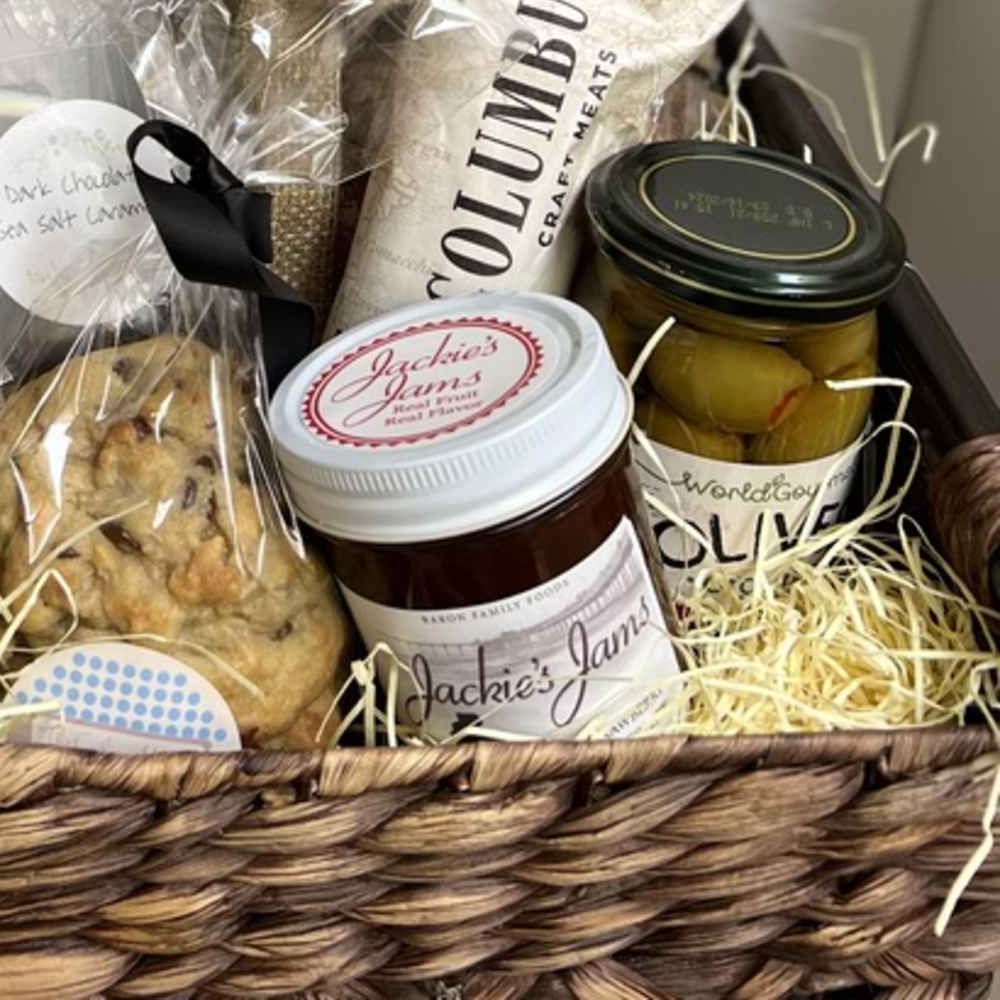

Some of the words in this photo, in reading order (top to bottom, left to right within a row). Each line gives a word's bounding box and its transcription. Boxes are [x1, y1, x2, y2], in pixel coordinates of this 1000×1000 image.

[538, 156, 575, 248] CRAFT
[573, 48, 617, 141] MEATS
[3, 177, 52, 205] Dark
[36, 208, 78, 235] Salt
[331, 332, 498, 403] Jackie's
[342, 369, 482, 428] Jams
[392, 398, 430, 415] Real
[434, 389, 479, 406] Fruit
[384, 411, 424, 428] Real
[471, 600, 522, 621] FAMILY
[404, 645, 555, 728] Jackie's
[550, 596, 650, 729] Jams
